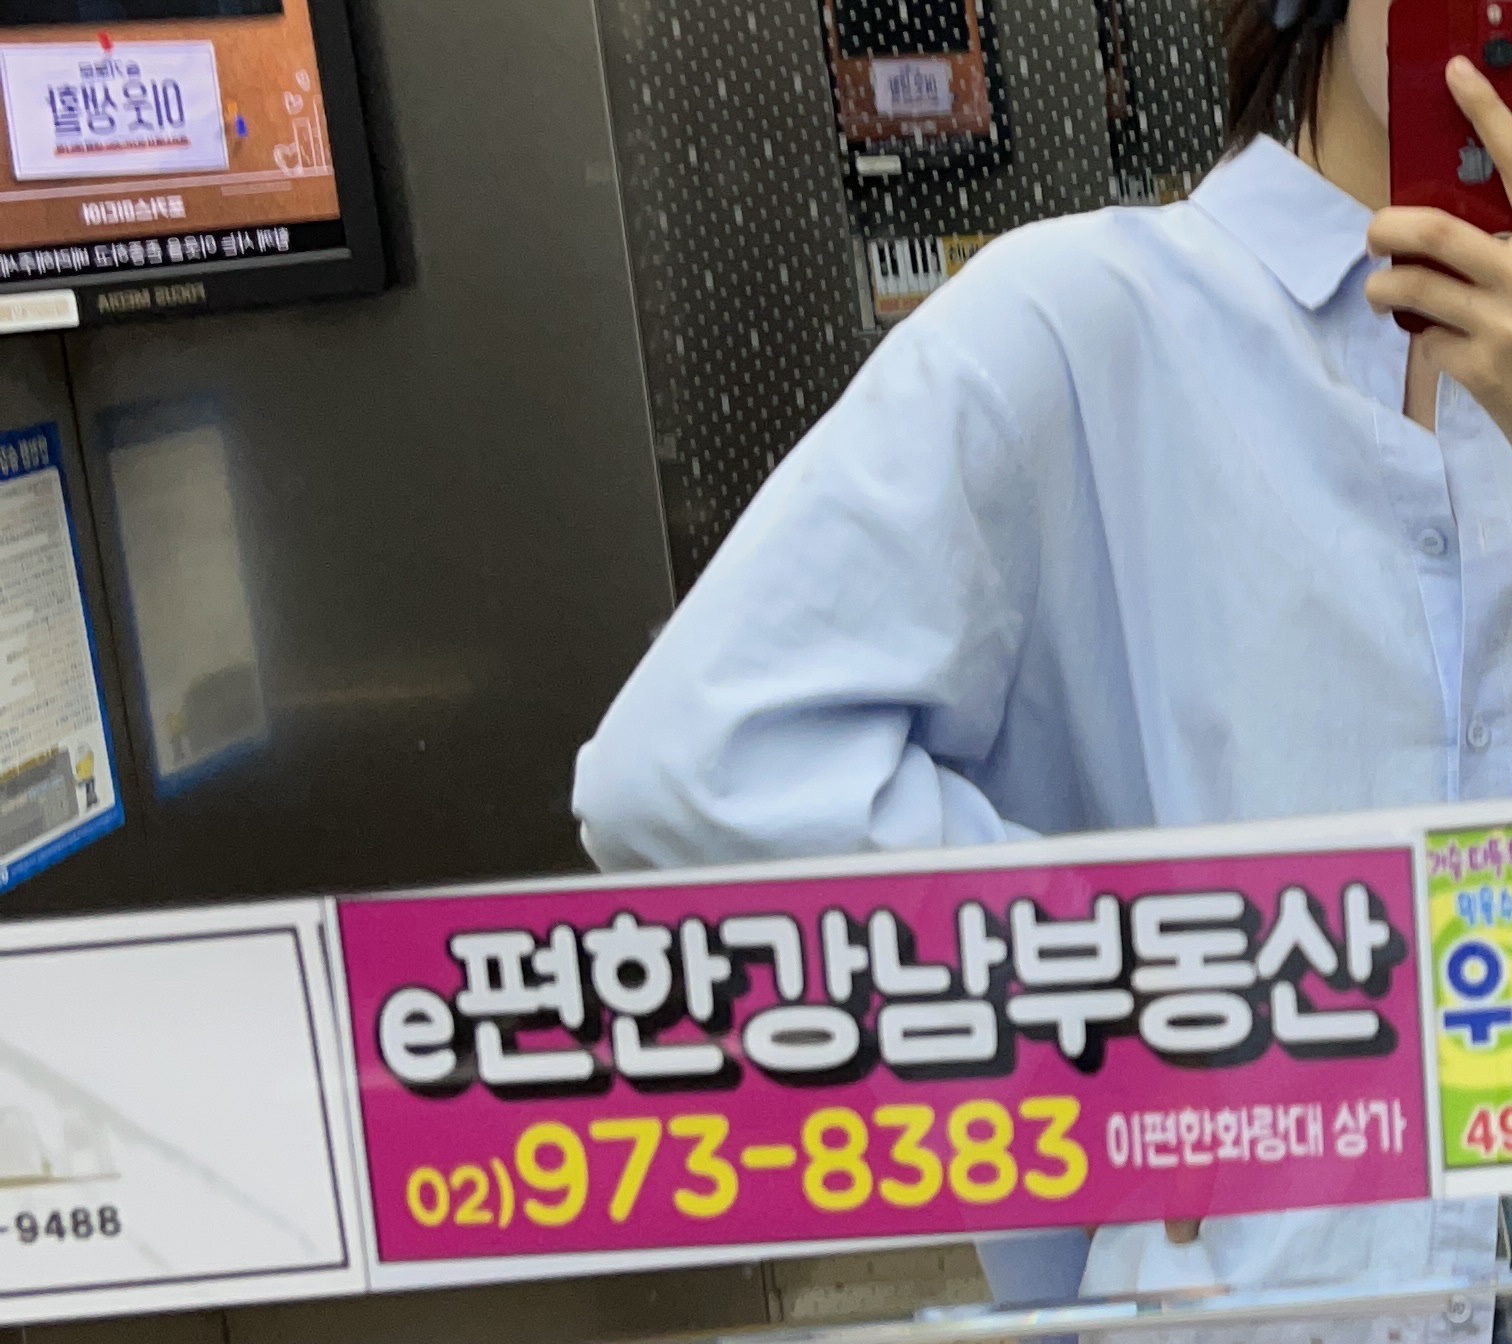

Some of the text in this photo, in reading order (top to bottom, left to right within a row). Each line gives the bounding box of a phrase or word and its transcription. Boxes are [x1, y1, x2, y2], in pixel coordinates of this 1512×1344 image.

[376, 882, 1403, 1094] e편한강남부동산
[1106, 1098, 1408, 1169] 이편한화랑대 상가
